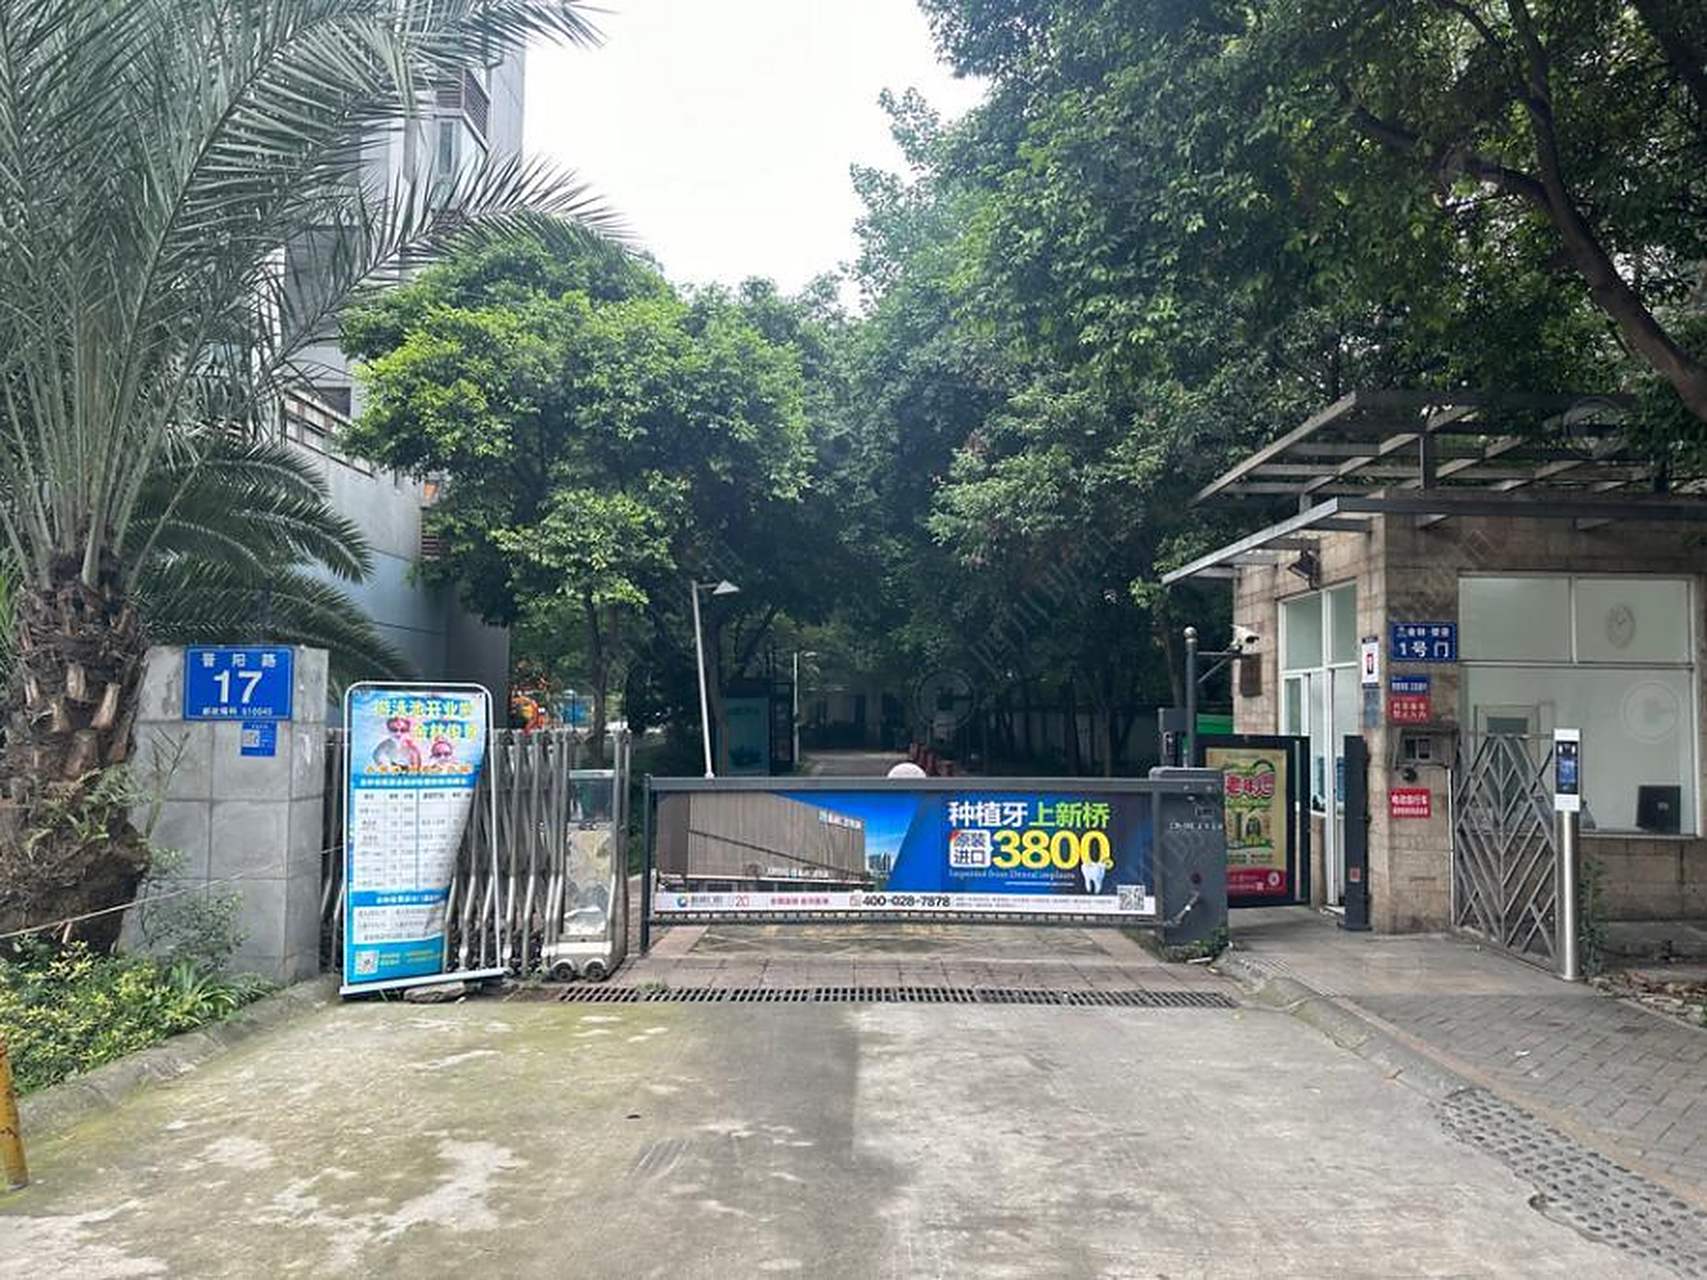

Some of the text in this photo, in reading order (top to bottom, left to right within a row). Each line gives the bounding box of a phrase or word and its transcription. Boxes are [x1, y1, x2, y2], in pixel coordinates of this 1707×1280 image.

[1400, 641, 1449, 658] 1号门
[203, 652, 276, 668] 晋阳路
[214, 670, 263, 704] 17
[954, 849, 986, 864] 进口
[992, 830, 1110, 869] 3800
[862, 894, 951, 907] 400-028-7878
